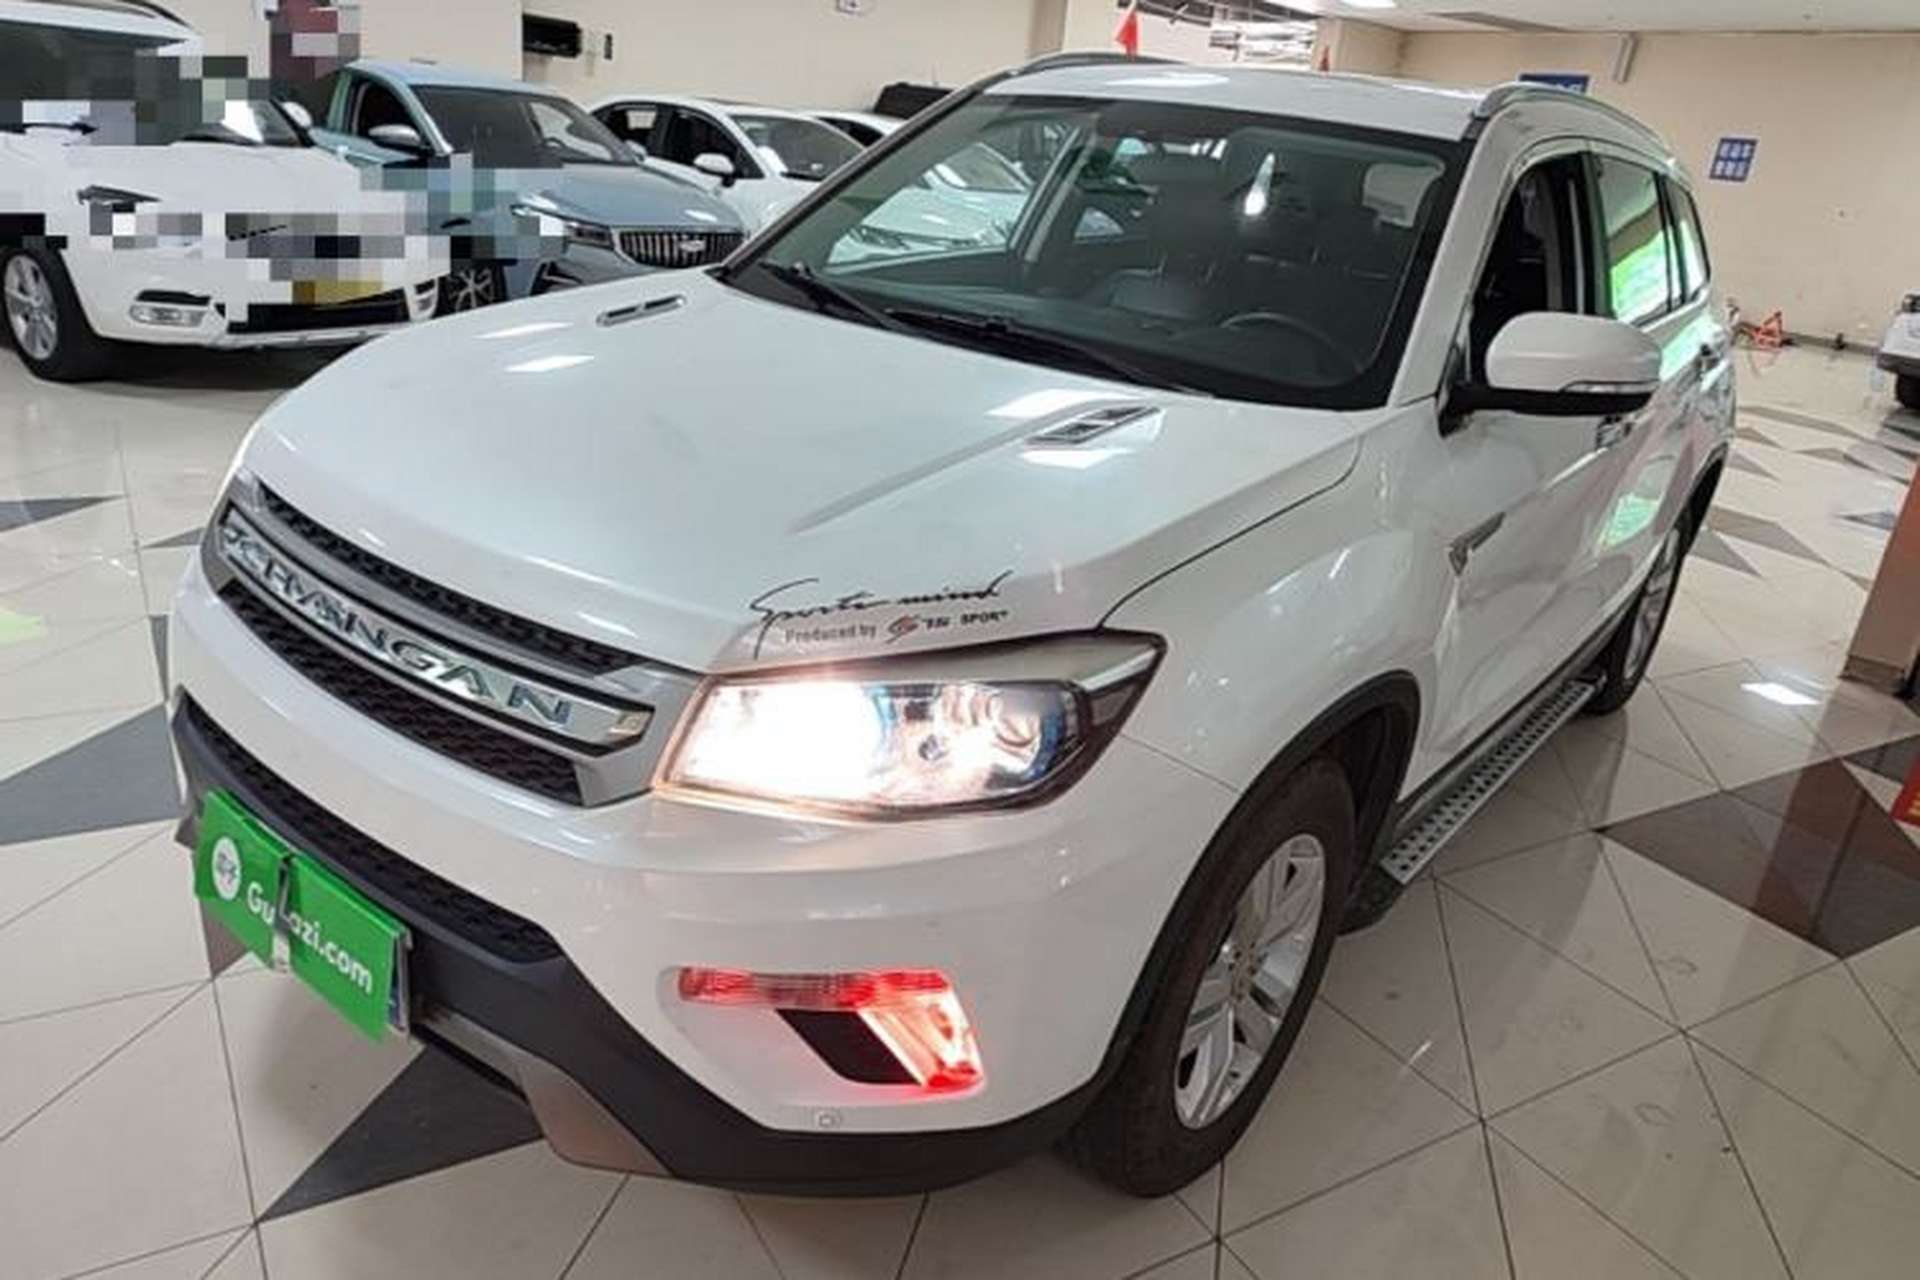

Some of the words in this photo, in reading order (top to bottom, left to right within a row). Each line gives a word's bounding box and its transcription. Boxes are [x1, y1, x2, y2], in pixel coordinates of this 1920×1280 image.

[222, 523, 572, 726] CHANGAN
[784, 624, 856, 643] Produced
[859, 623, 877, 639] by
